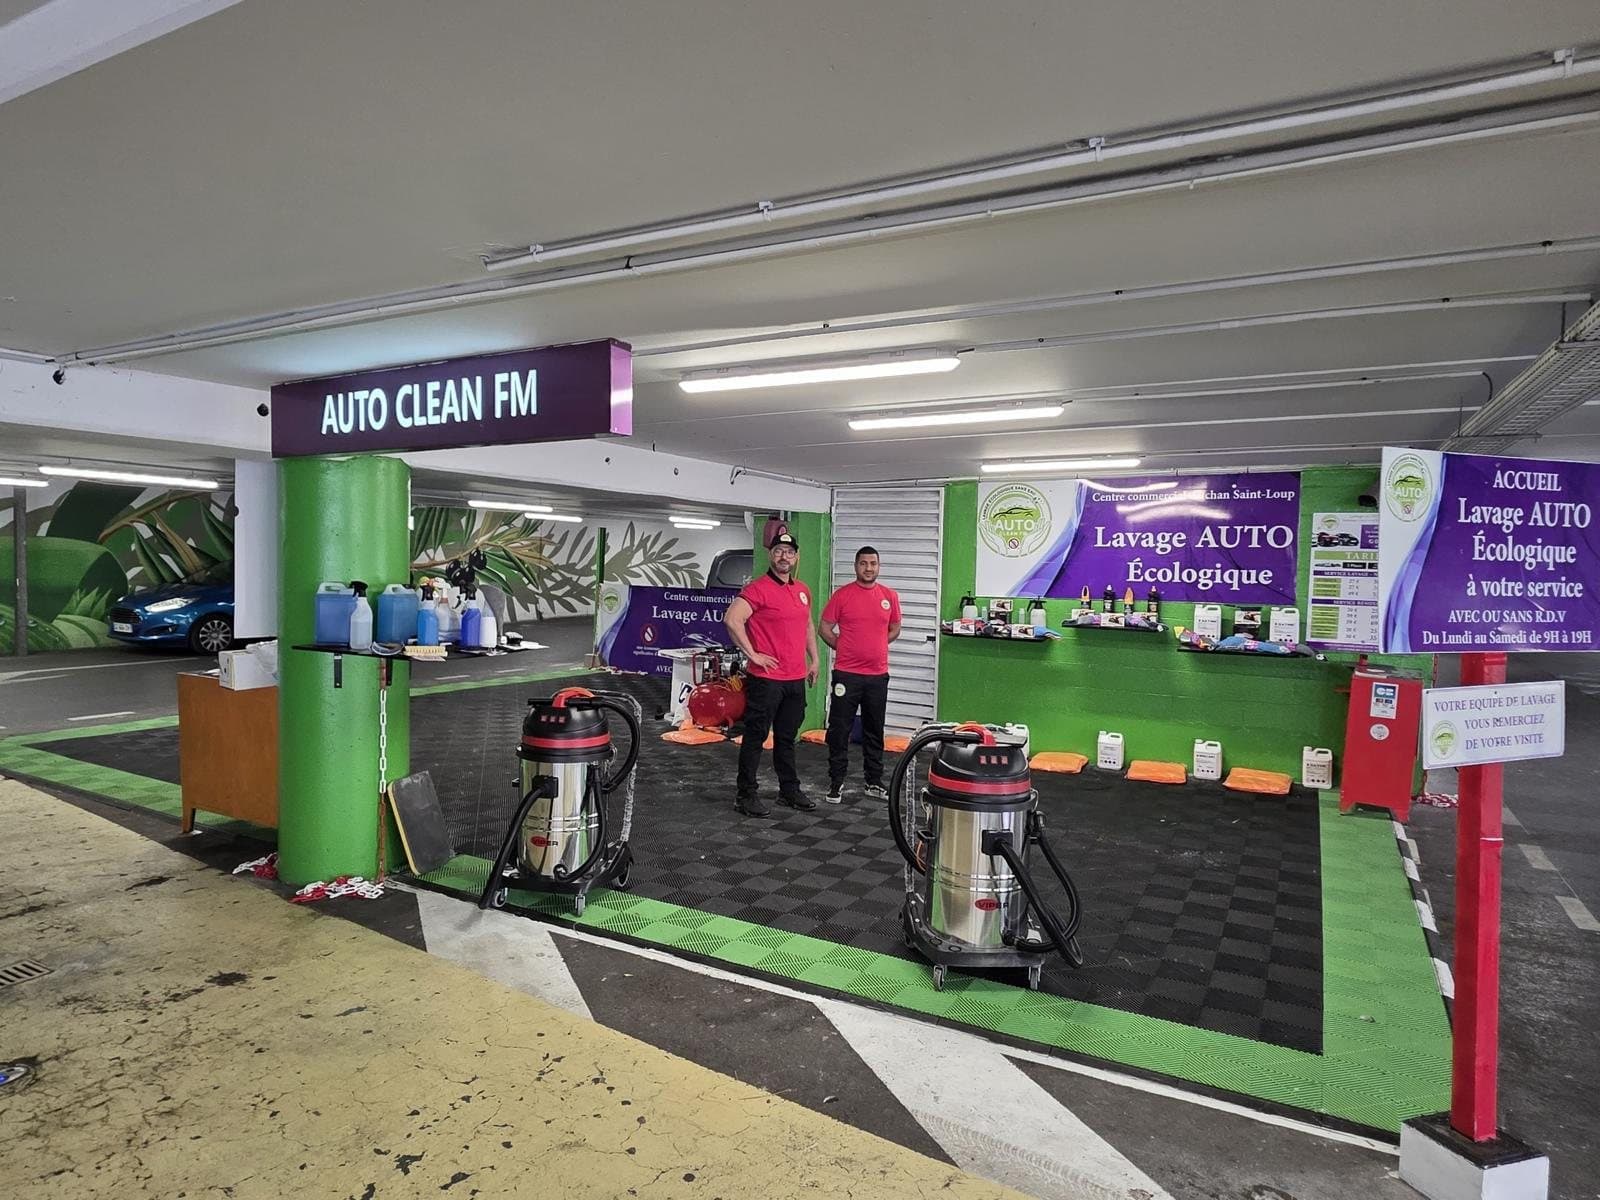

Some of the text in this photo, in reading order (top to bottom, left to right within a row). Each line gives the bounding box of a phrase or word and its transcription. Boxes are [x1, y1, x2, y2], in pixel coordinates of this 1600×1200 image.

[321, 369, 537, 435] AUTO CLEAN FM
[1492, 470, 1562, 492] ACCUEIL
[1092, 493, 1125, 502] Centre
[1233, 489, 1296, 501] Saint-Loup
[1458, 497, 1591, 533] Lavage AUTO
[995, 519, 1035, 531] AUTO
[1094, 525, 1294, 555] Lavage AUTO
[1472, 530, 1577, 571] Écologique
[1127, 557, 1273, 590] Écologique
[1466, 574, 1583, 598] à votre service
[664, 592, 735, 604] Centre commercial
[652, 606, 726, 623] Lavage AU
[1448, 610, 1567, 623] AVEC OU SANS R.D.V
[1422, 630, 1592, 645] Du Lundi au Samedi de 9H à 19H
[656, 665, 673, 673] AVEC
[1434, 693, 1557, 712] VOTRE EQUIPE DE LAVAGE
[1465, 714, 1545, 730] VOUS REMERCIEZ
[1465, 733, 1544, 750] DE VOTRE VISITE
